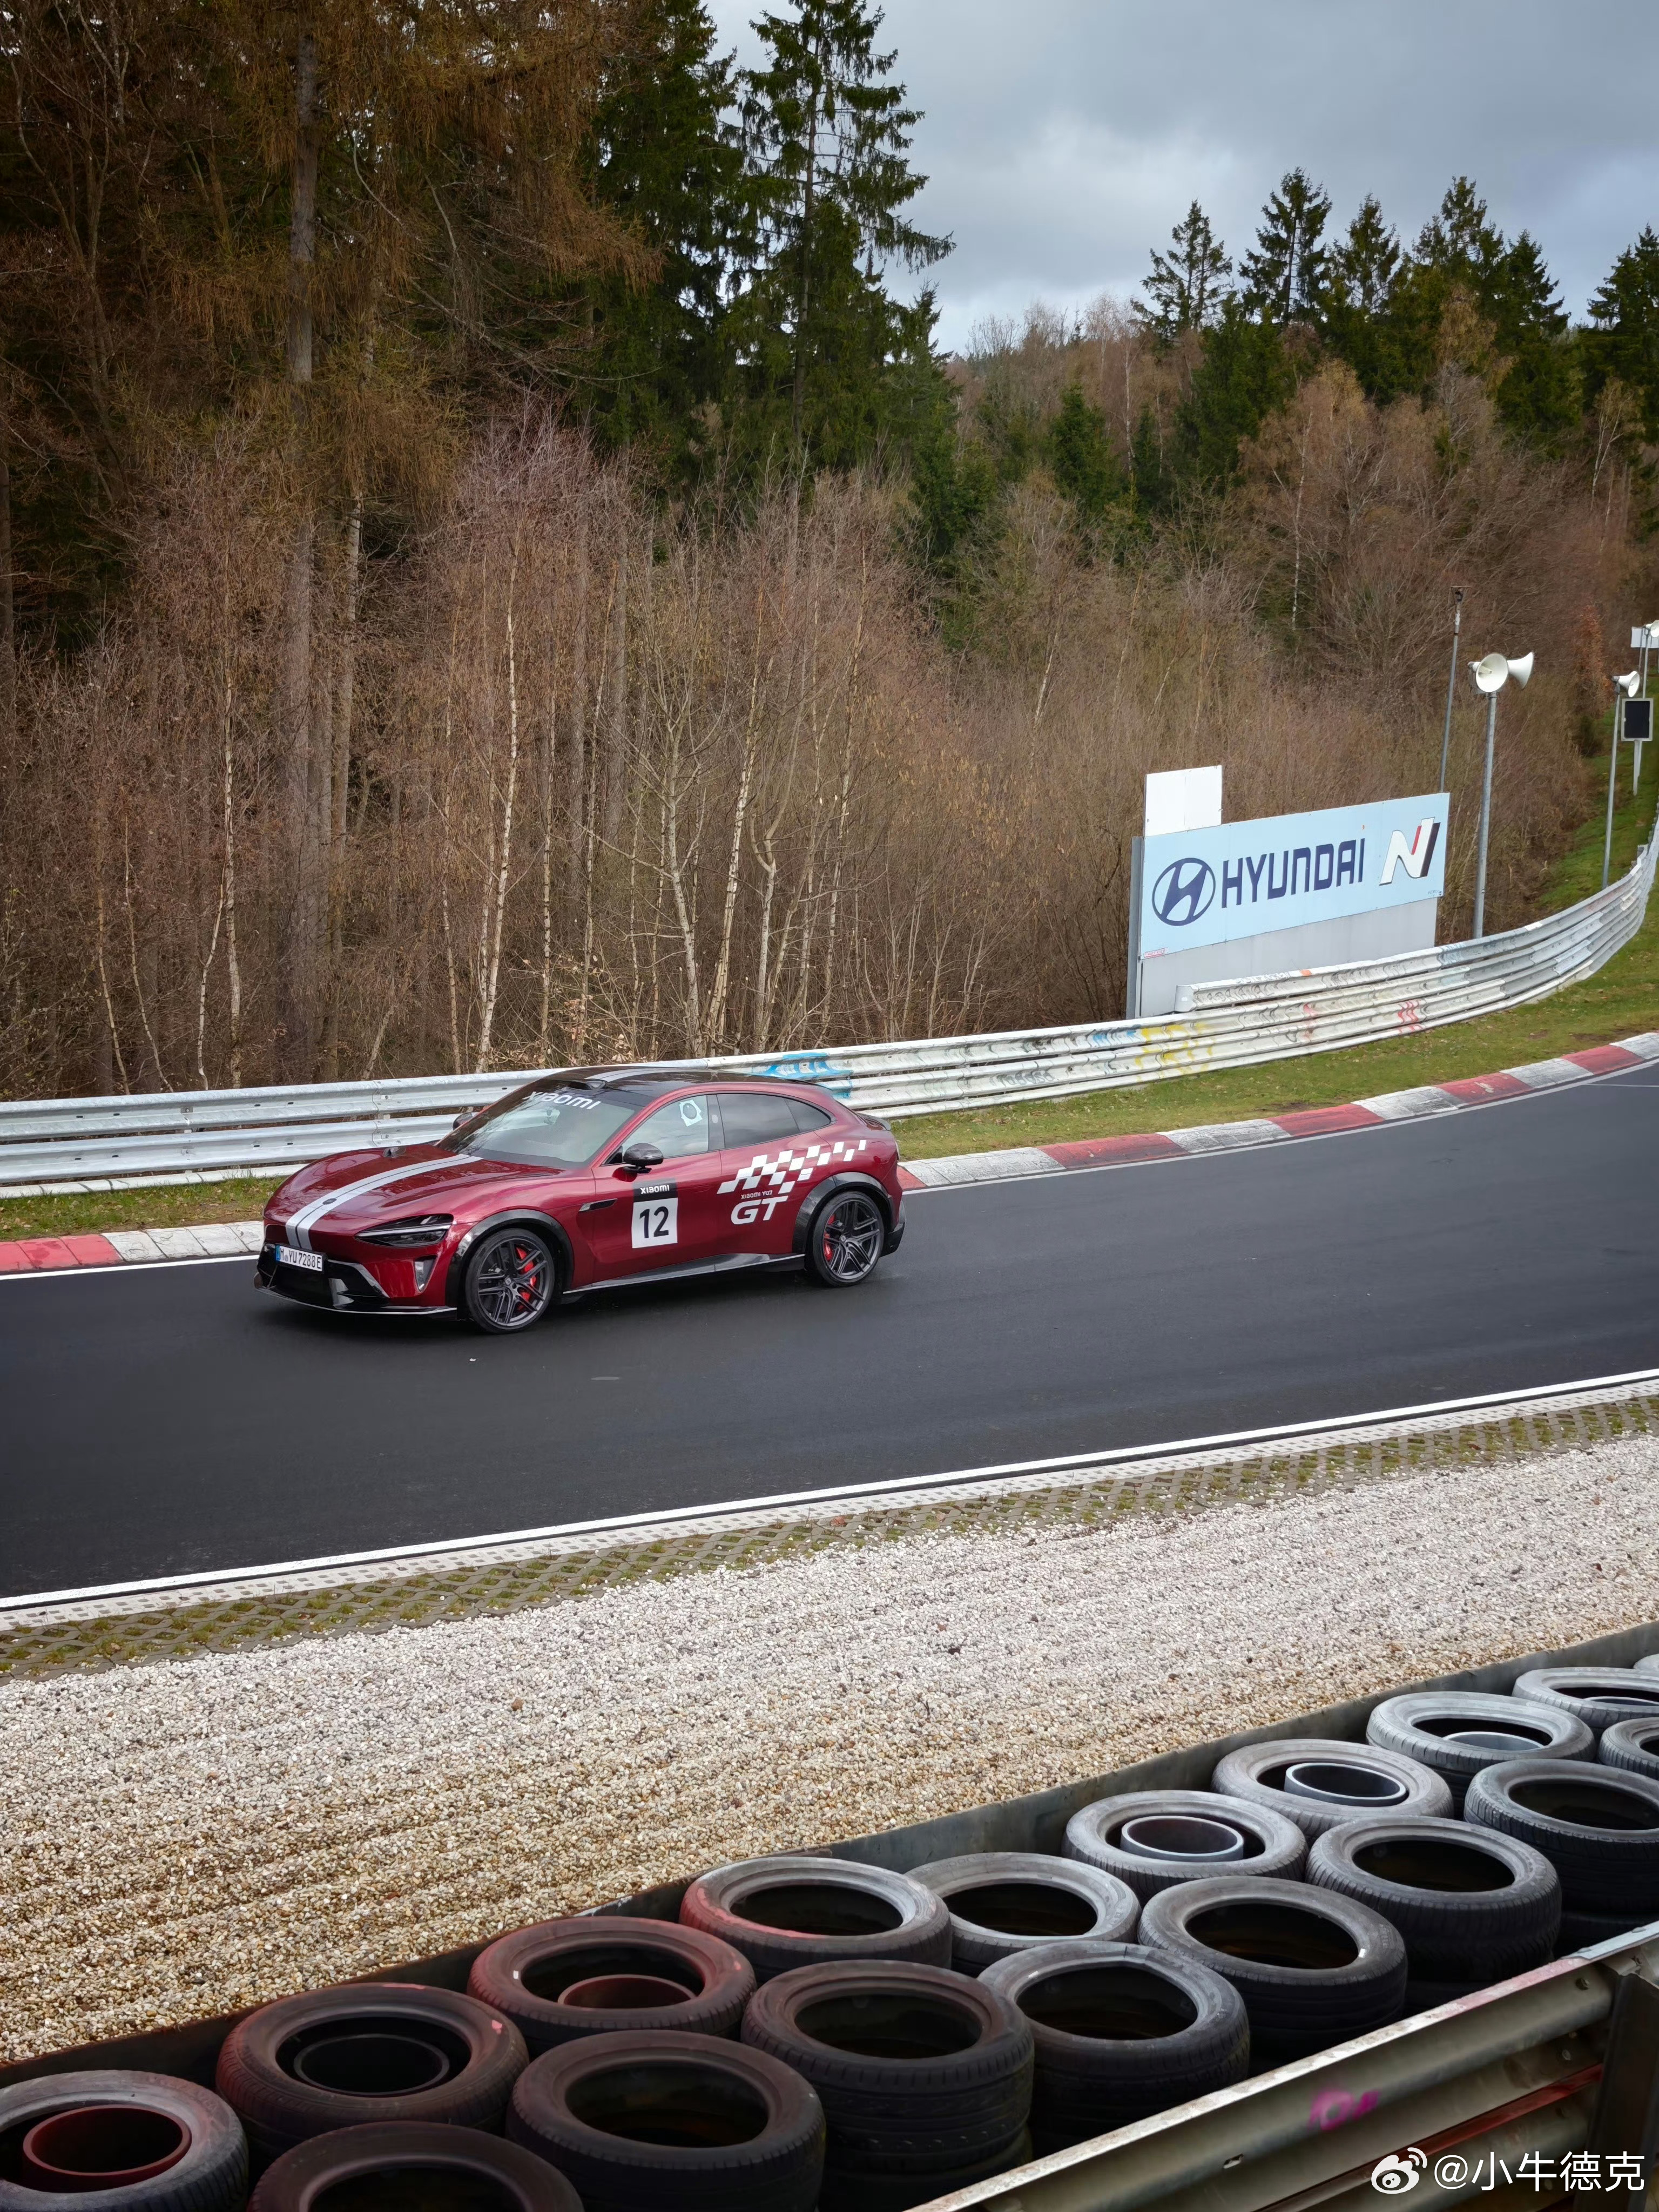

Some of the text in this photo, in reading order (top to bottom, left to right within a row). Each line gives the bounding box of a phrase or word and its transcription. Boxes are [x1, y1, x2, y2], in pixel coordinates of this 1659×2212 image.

[1222, 838, 1365, 908] HYUNDAI
[1379, 817, 1440, 886] N
[639, 1206, 669, 1238] 12
[731, 1196, 788, 1225] GT
